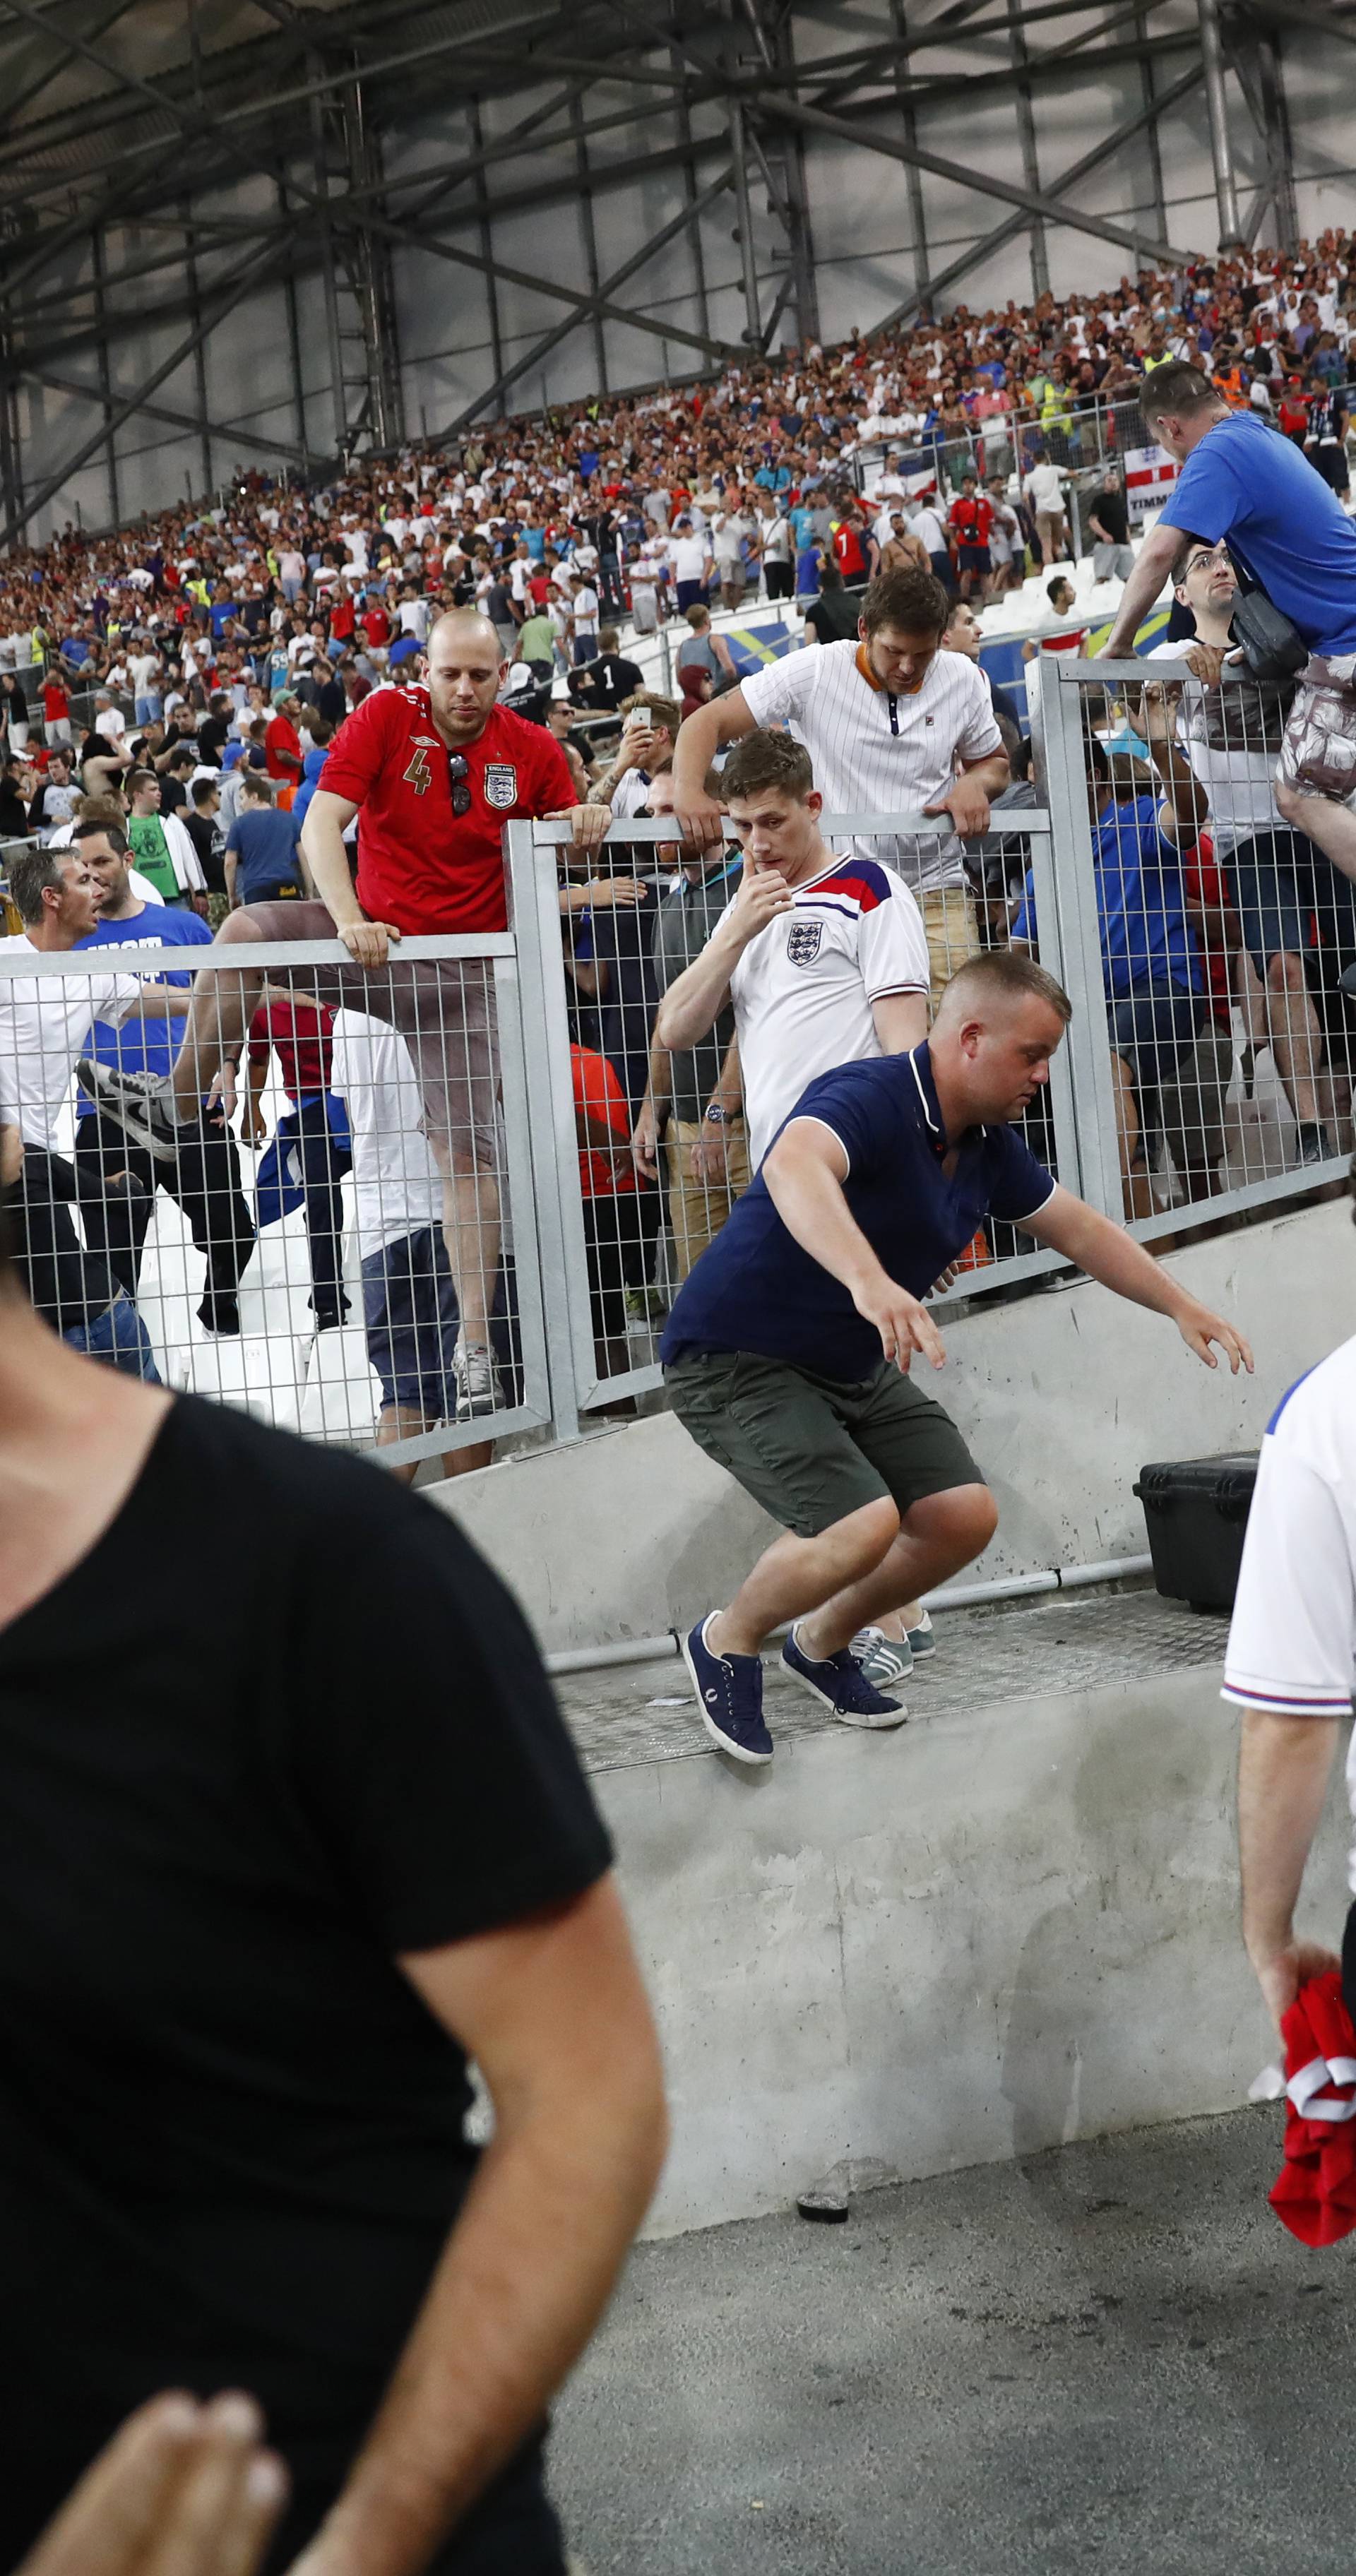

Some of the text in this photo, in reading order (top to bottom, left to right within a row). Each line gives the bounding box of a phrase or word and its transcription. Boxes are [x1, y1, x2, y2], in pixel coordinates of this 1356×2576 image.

[1130, 494, 1171, 511] TIMM
[603, 664, 614, 689] 1
[403, 749, 432, 795] 4
